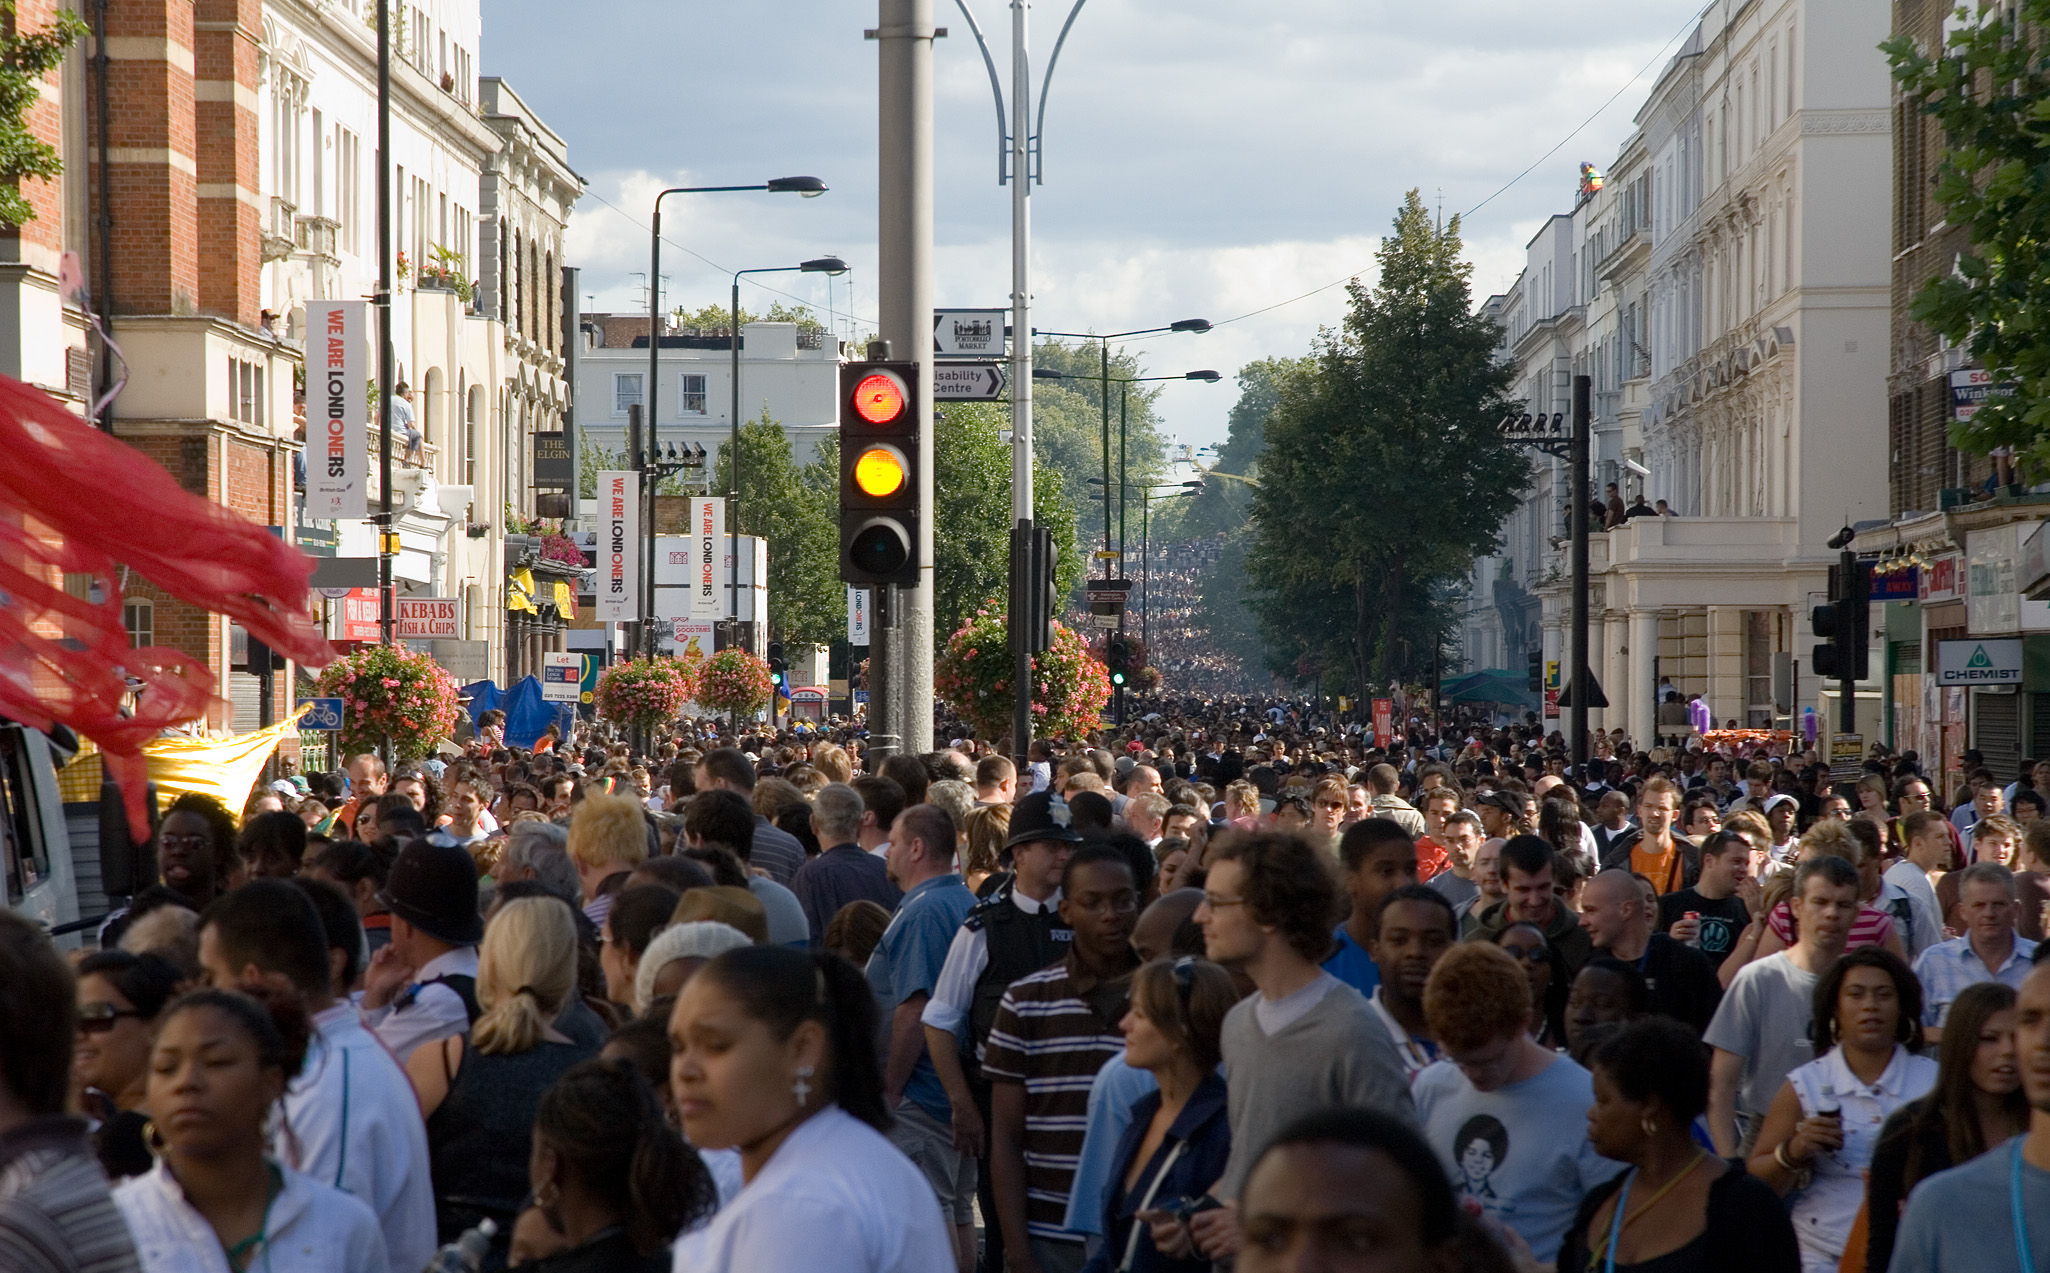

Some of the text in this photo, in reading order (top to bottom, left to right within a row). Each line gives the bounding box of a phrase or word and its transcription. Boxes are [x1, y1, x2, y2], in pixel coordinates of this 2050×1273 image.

[933, 370, 982, 382] isability
[328, 309, 345, 477] WE ARE LONDONERS
[933, 382, 972, 393] Centre
[542, 439, 565, 449] THE
[537, 450, 570, 459] ELGIN
[611, 478, 624, 593] WE ARE LONDONERS
[702, 503, 713, 596] WE ARE LONDONERS
[400, 603, 455, 619] KEBABS
[399, 619, 455, 634] FISH & CHIPS
[1944, 669, 2020, 680] CHEMIST
